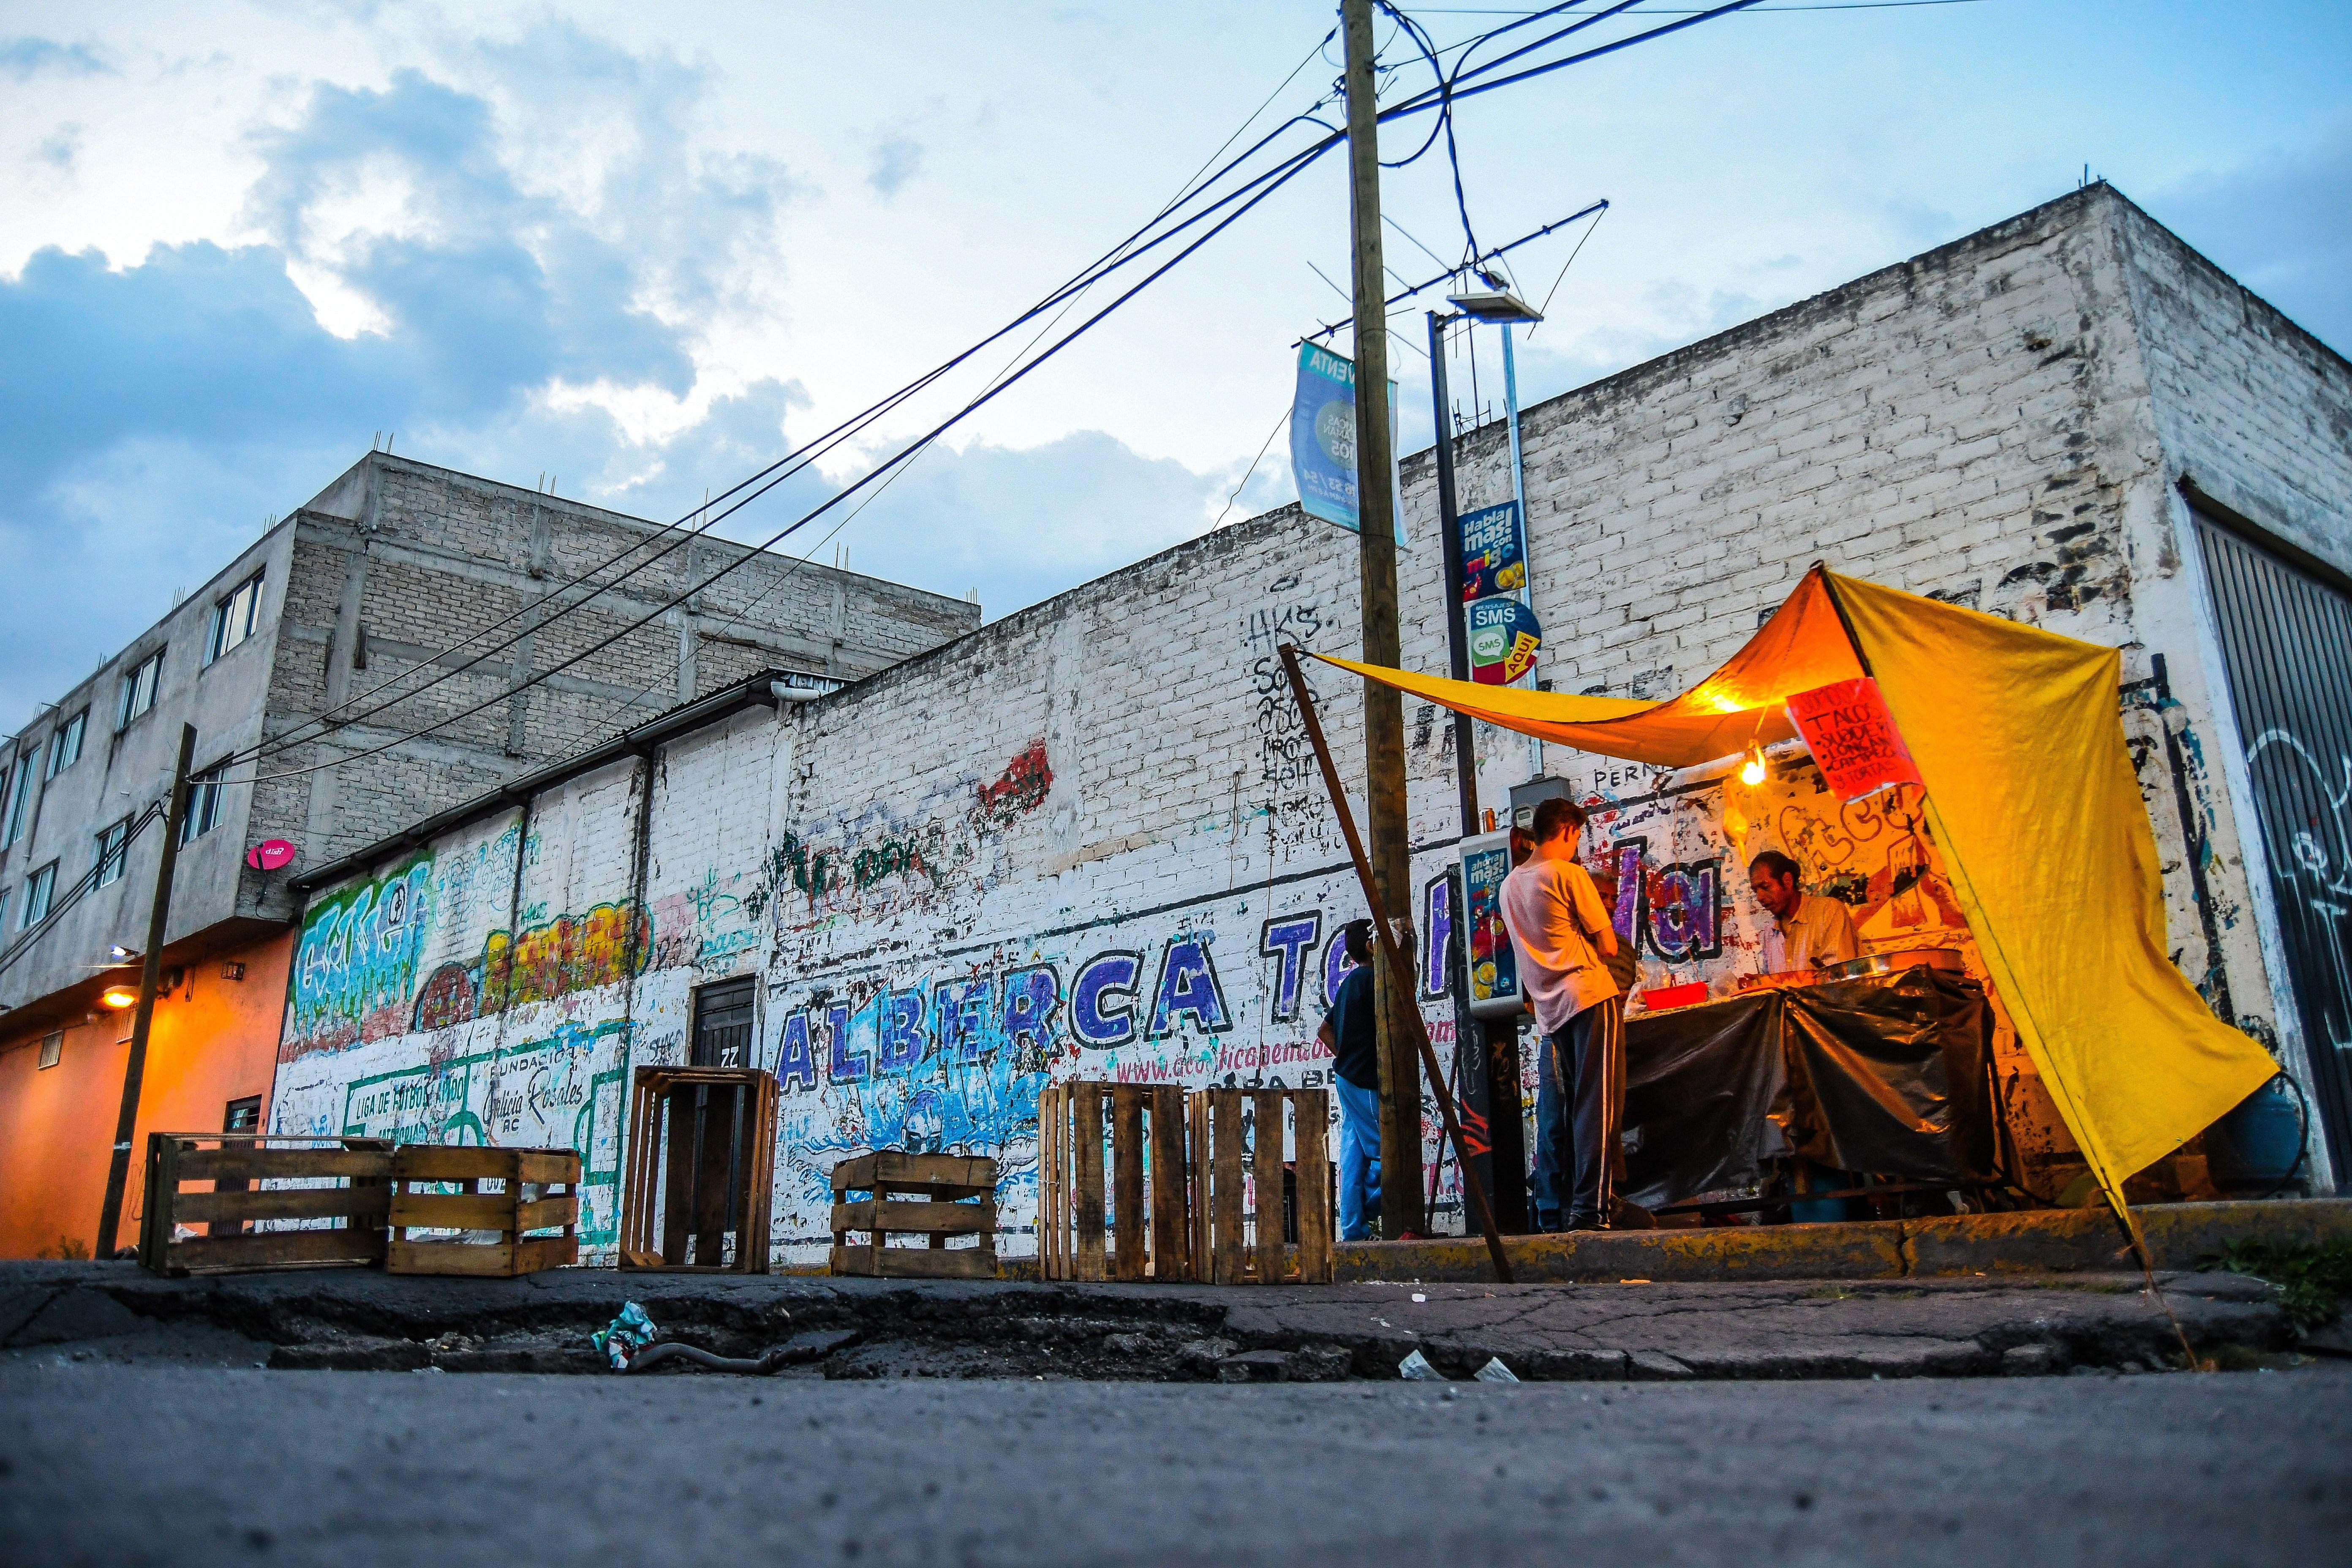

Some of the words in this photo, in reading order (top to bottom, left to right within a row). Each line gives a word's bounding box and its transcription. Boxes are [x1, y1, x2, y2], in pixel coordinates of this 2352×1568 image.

[1465, 510, 1505, 536] Habla
[1493, 534, 1512, 548] con
[1467, 543, 1515, 574] migo
[1476, 608, 1516, 626] SMS
[1478, 639, 1500, 651] SMS
[265, 847, 284, 855] dish
[774, 938, 1233, 1096] ALBERCA
[356, 1094, 375, 1120] LIGA
[378, 1091, 390, 1115] DE
[528, 1066, 583, 1125] Rosales
[503, 1118, 520, 1133] AC
